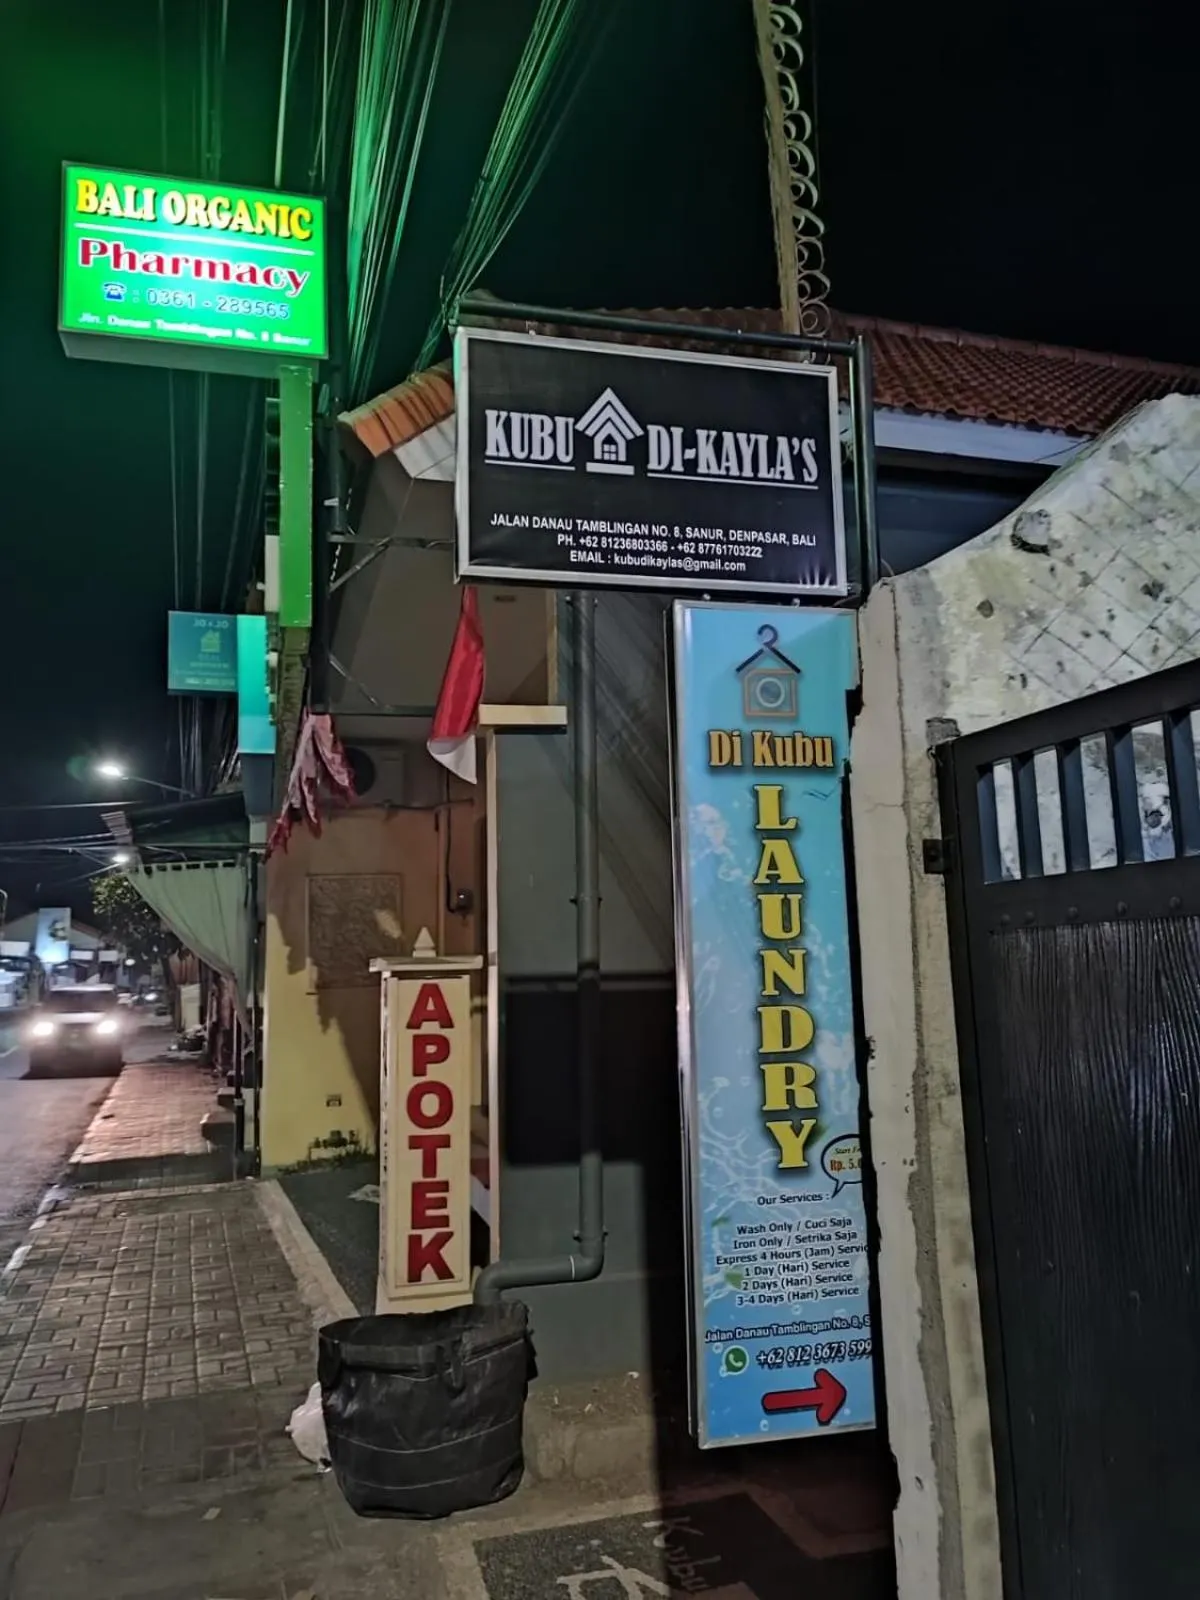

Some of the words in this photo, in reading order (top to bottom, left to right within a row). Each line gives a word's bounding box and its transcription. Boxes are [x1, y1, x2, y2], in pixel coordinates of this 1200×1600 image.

[76, 179, 157, 221] BALI
[162, 191, 312, 240] ORGANIC
[79, 238, 310, 296] Pharmacy
[147, 289, 195, 308] 0361
[216, 296, 290, 319] 289565
[485, 409, 575, 462] KUBU
[647, 424, 818, 483] DI-KAYLA'S
[491, 513, 529, 528] JALAN
[532, 516, 573, 530] DANAU
[576, 519, 649, 535] TAMBLINGAN
[651, 524, 671, 537] NO.
[673, 526, 683, 538] 8,
[686, 527, 726, 541] SANUR,
[729, 529, 790, 546] DENPASAR,
[792, 534, 816, 546] BALI
[557, 533, 576, 546] PH.
[579, 535, 598, 548] +62
[601, 536, 668, 552] 81236803366
[677, 542, 695, 554] +62
[570, 550, 604, 563] EMAIL
[614, 553, 746, 571] kubudikaylas@gmail.com
[708, 730, 743, 767] Di
[752, 730, 834, 768] Kubu
[752, 784, 819, 1169] LAUNDRY
[406, 983, 455, 1283] APOTEK
[757, 1196, 776, 1206] Our
[779, 1193, 823, 1204] Services
[737, 1224, 765, 1235] Wash
[769, 1222, 792, 1234] Only
[805, 1219, 827, 1229] Cuci
[830, 1217, 852, 1228] Saja
[734, 1240, 756, 1250] Iron
[759, 1237, 783, 1249] Only
[795, 1233, 832, 1245] Setrika
[835, 1230, 858, 1242] Saja
[716, 1254, 758, 1266] Express
[761, 1252, 767, 1260] 4
[771, 1250, 801, 1260] Hours
[804, 1246, 835, 1258] (Jam)
[745, 1268, 750, 1276] 1
[754, 1266, 774, 1278] Day
[777, 1262, 809, 1275] (Hari)
[812, 1260, 850, 1272] Service
[743, 1282, 748, 1291] 2
[752, 1280, 778, 1291] Days
[781, 1276, 813, 1289] (Hari)
[815, 1274, 853, 1285] Service
[737, 1296, 754, 1306] 3-4
[759, 1293, 784, 1304] Days
[787, 1290, 819, 1301] (Hari)
[821, 1287, 859, 1298] Service
[705, 1330, 733, 1342] Jalan
[736, 1327, 769, 1339] Danau
[773, 1320, 831, 1336] Tamblingan
[833, 1318, 850, 1329] No.
[757, 1348, 784, 1365] +62
[786, 1346, 811, 1362] 812
[814, 1342, 846, 1357] 3673
